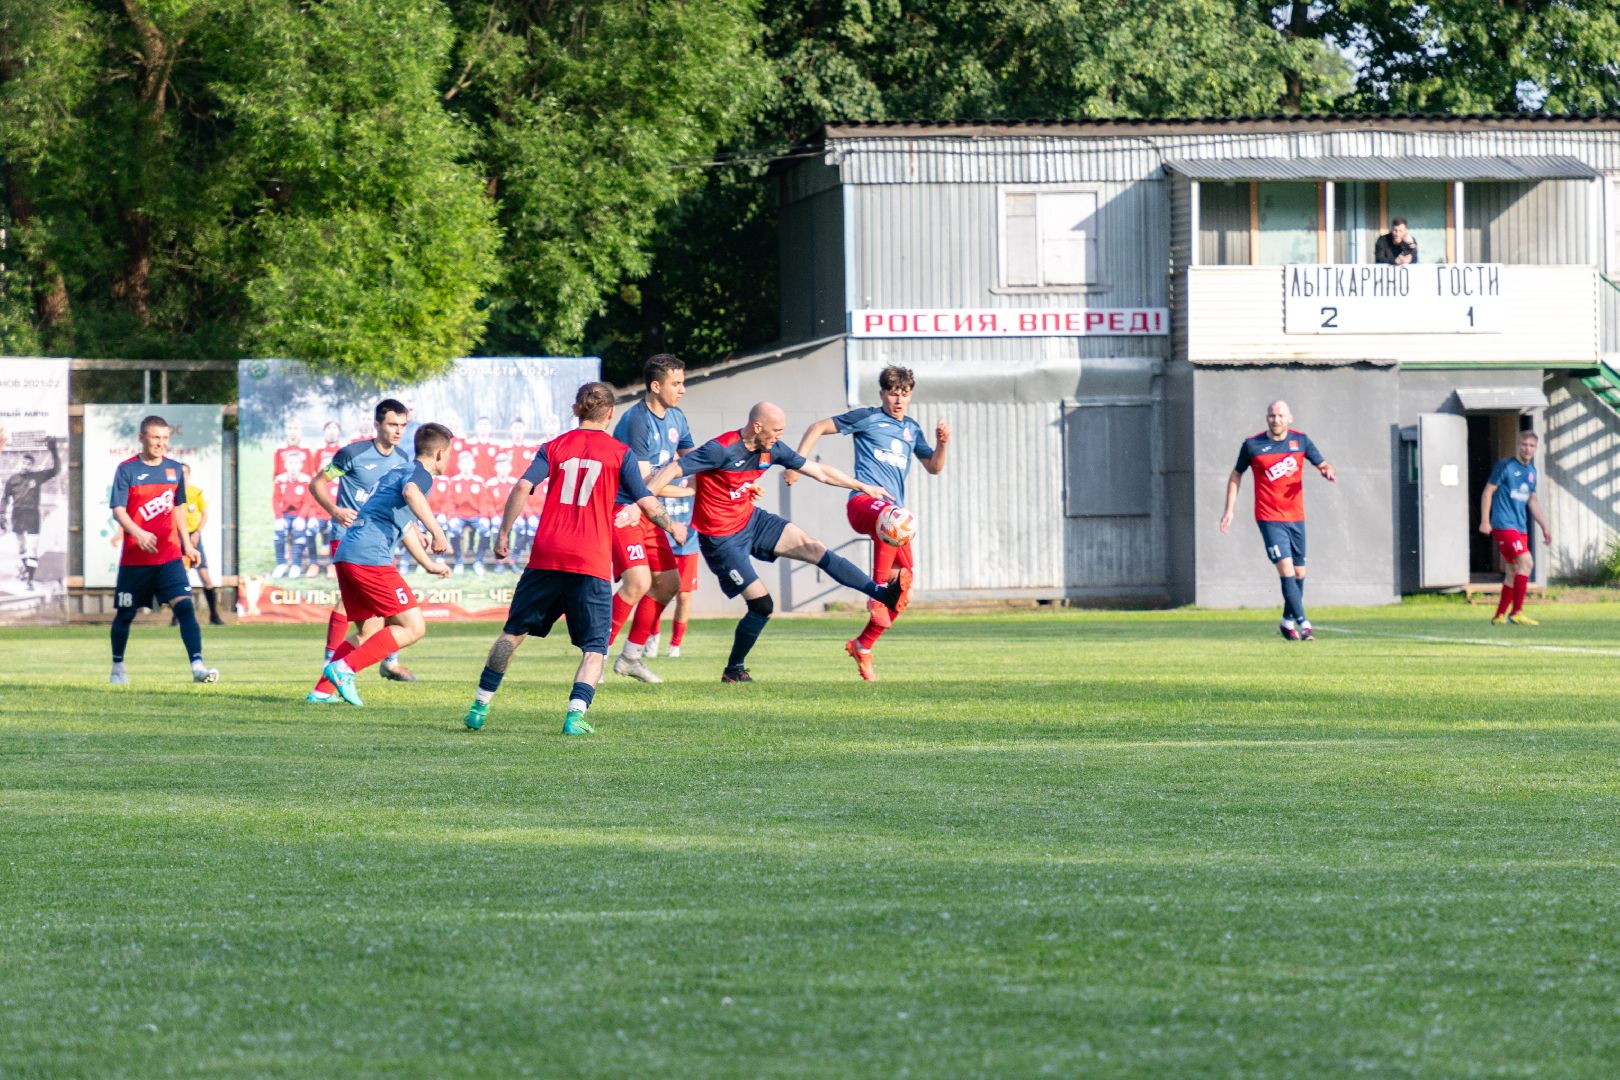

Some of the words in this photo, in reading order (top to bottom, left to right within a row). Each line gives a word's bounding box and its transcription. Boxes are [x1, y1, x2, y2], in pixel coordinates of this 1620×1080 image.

[1291, 266, 1410, 297] ЛЫТКАРИНО
[1436, 266, 1500, 297] ГОСТИ
[1018, 311, 1161, 333] ВПЕРЕД!
[1320, 307, 1338, 328] 2
[1466, 306, 1475, 327] 1
[559, 457, 603, 506] 17
[627, 544, 645, 560] 20
[729, 569, 744, 586] 9
[118, 592, 132, 607] 18
[270, 589, 301, 605] СШ
[428, 589, 462, 603] 2011
[396, 588, 408, 605] 5
